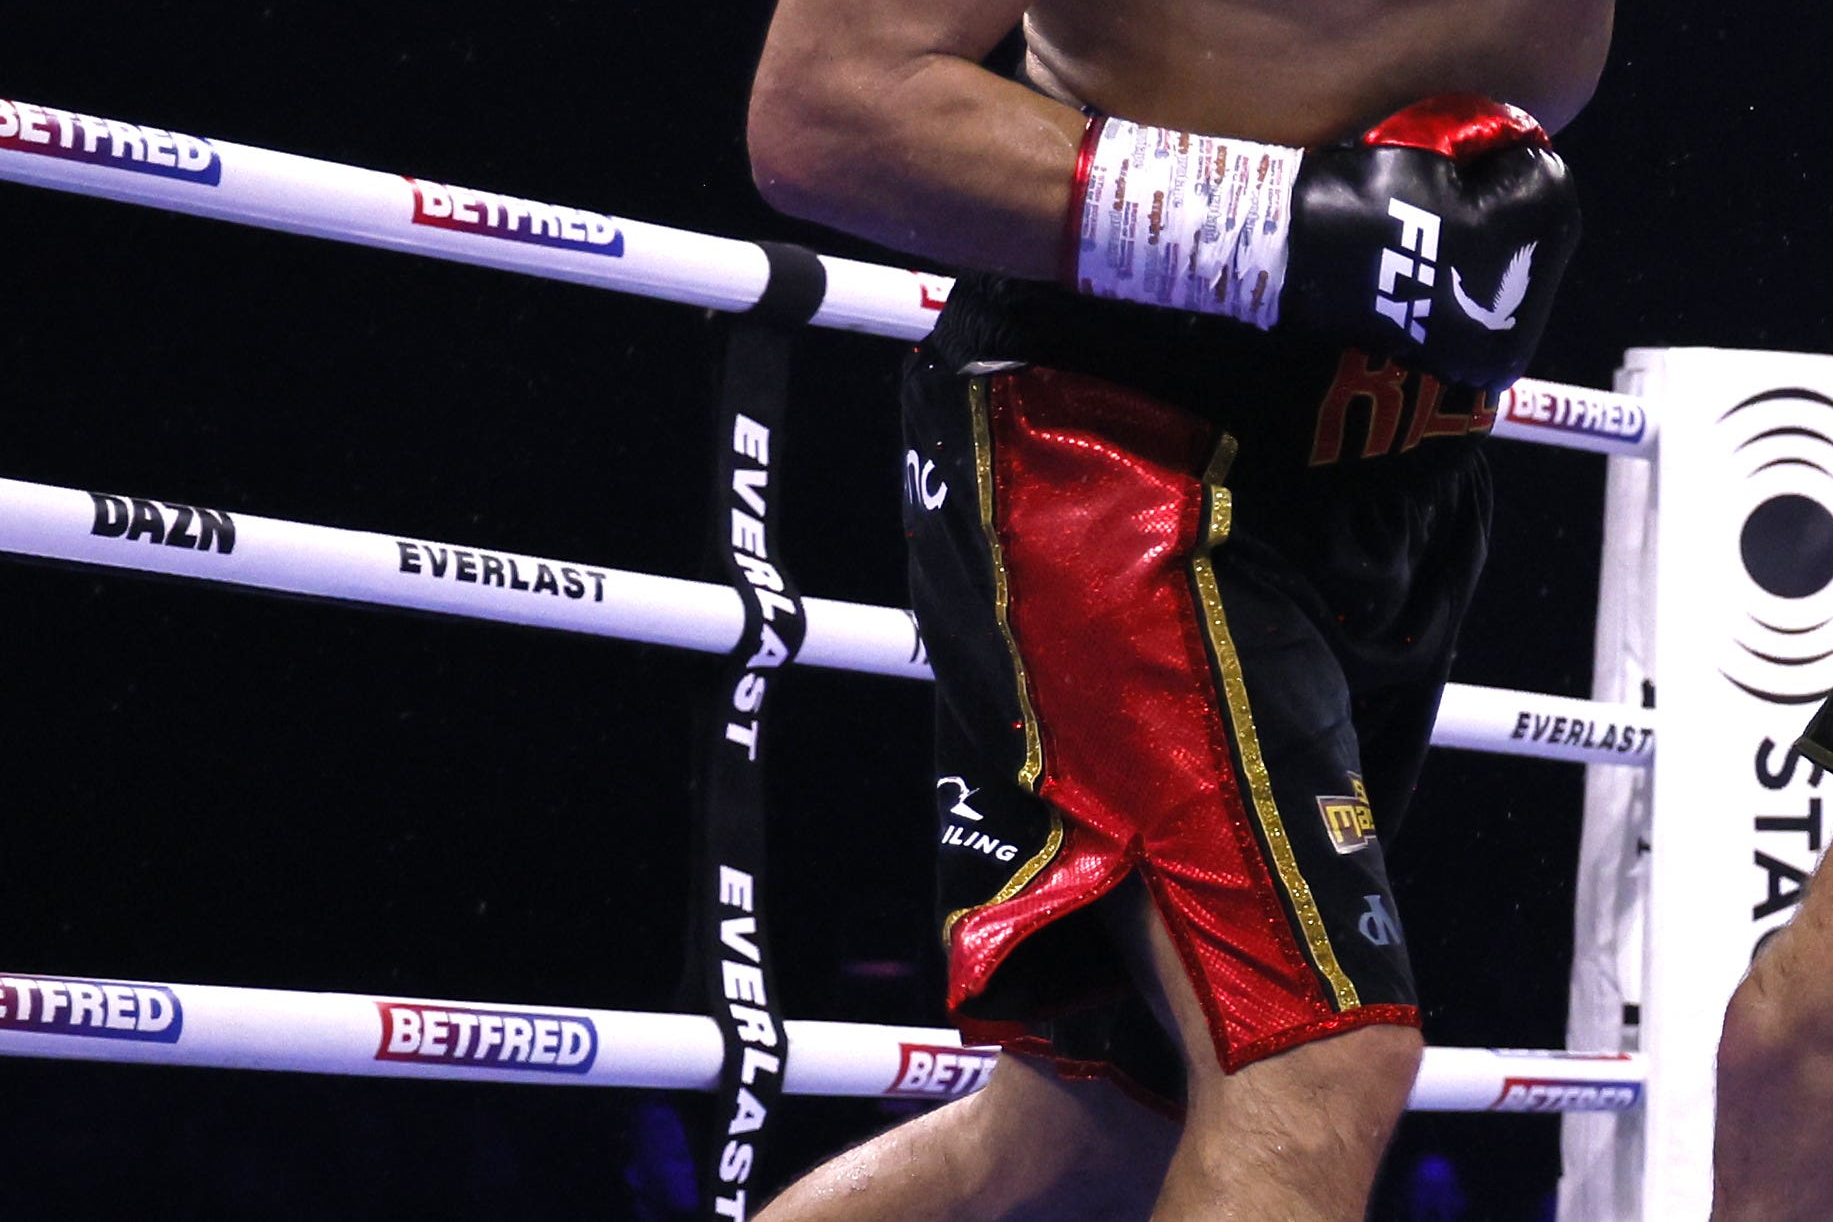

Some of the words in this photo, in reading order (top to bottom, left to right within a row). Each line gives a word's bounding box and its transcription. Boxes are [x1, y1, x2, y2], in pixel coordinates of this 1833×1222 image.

[415, 178, 618, 245] BETFRED
[1375, 196, 1442, 345] FLY
[1512, 381, 1644, 436] BETFRED
[88, 490, 236, 555] DAZN
[396, 541, 607, 603] EVERLAST
[724, 413, 798, 761] EVERLAST
[1510, 712, 1653, 754] EVERLAST
[387, 1007, 591, 1066] BETFRED
[715, 864, 780, 1222] EVERLAST
